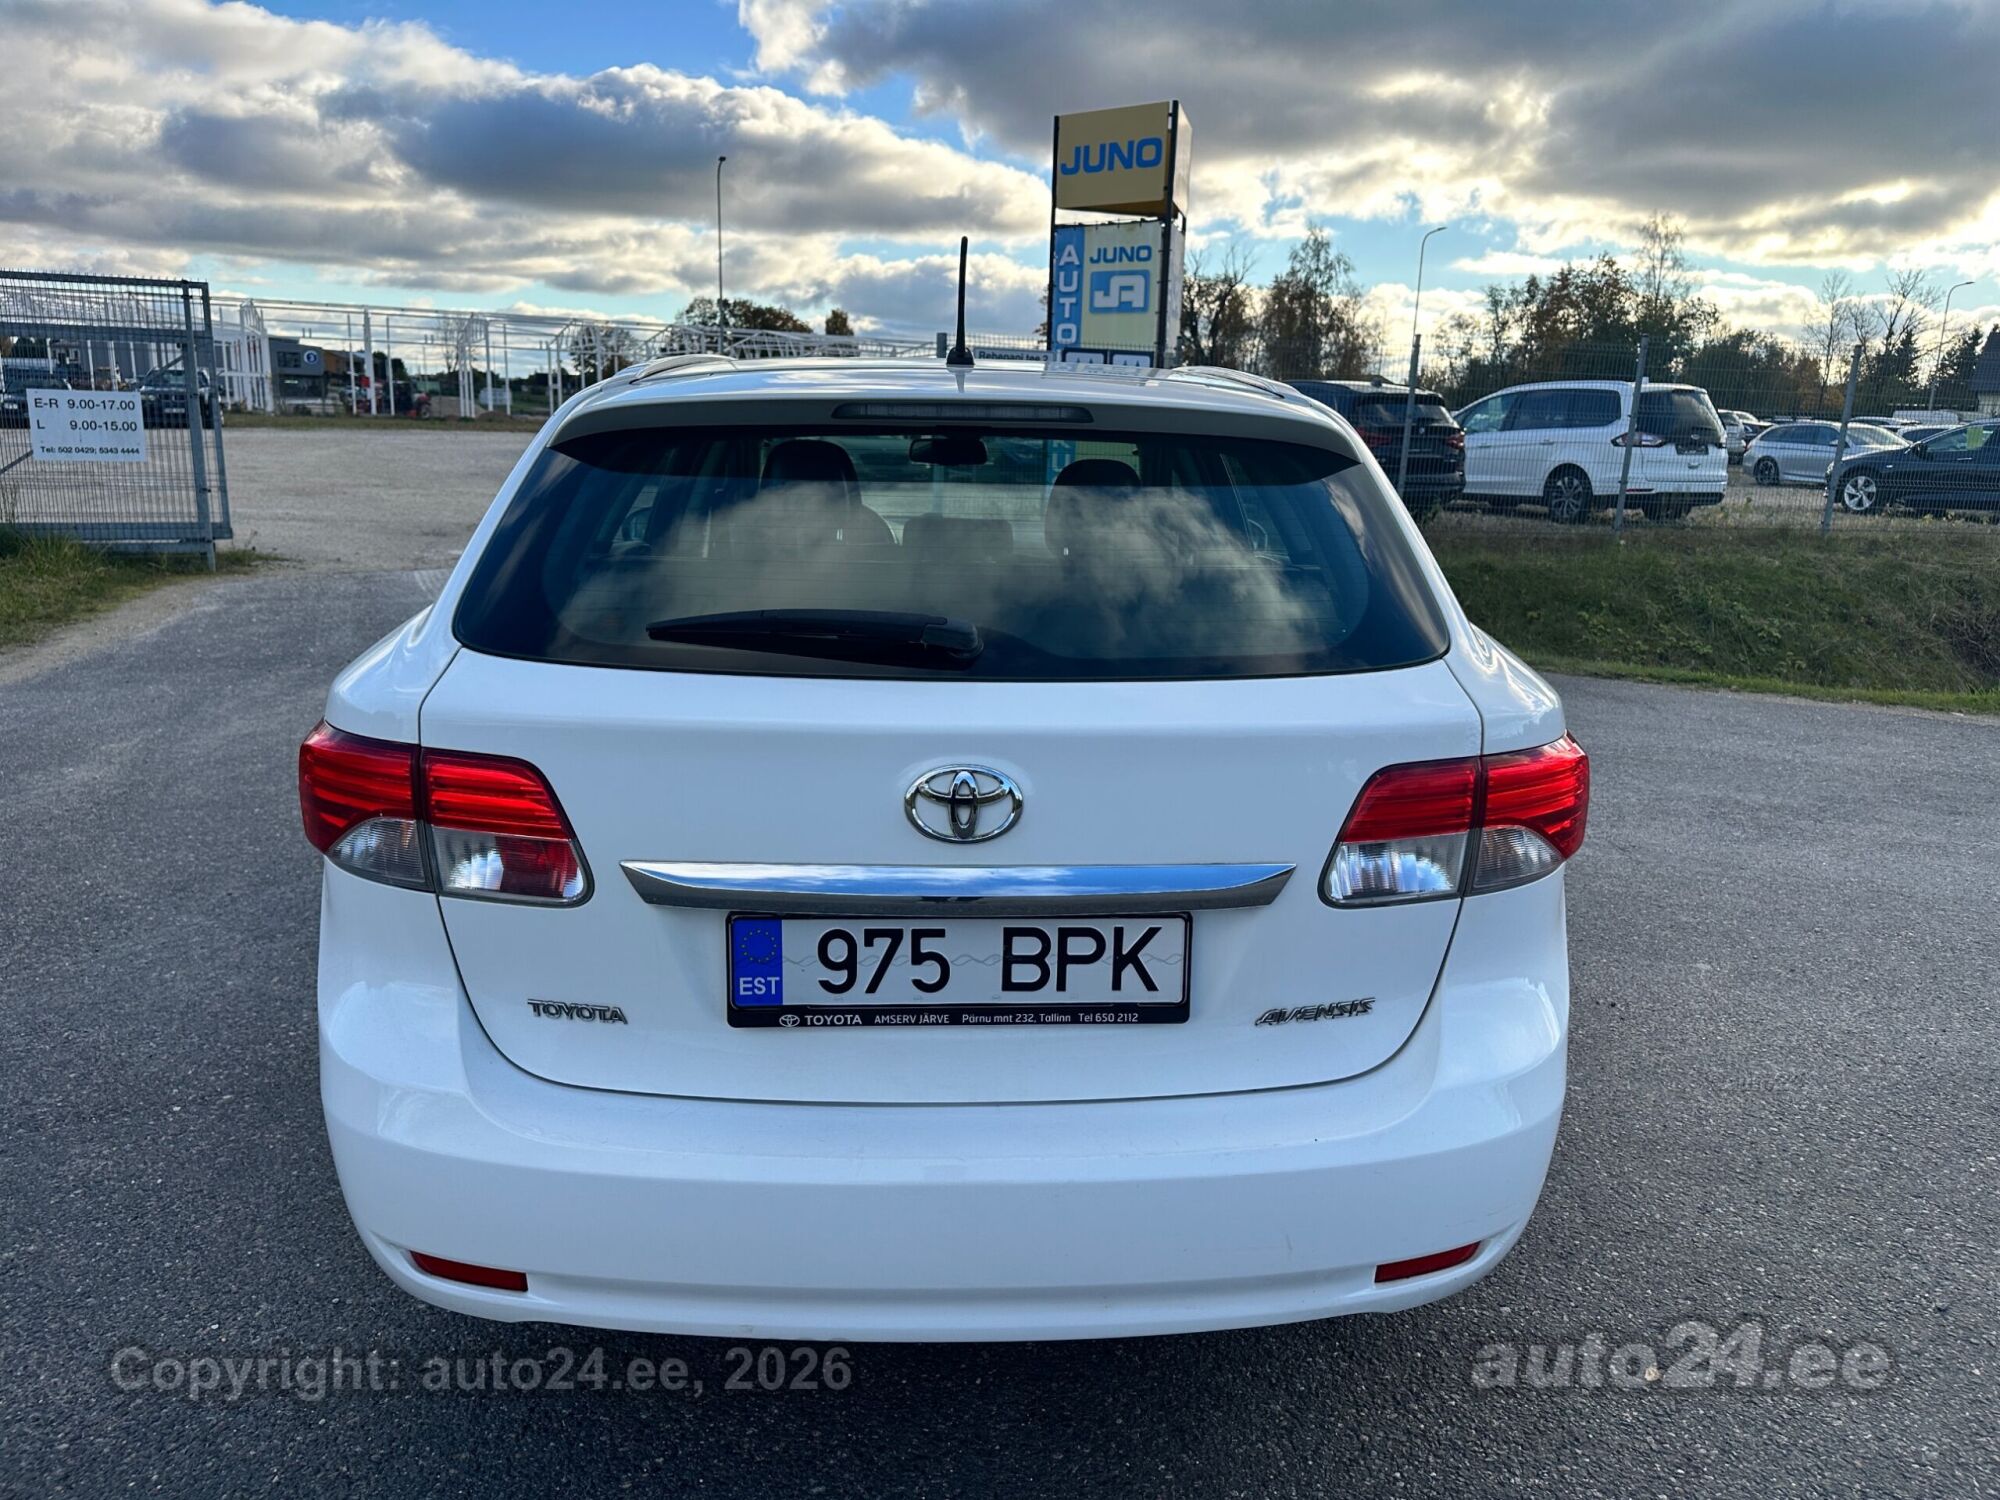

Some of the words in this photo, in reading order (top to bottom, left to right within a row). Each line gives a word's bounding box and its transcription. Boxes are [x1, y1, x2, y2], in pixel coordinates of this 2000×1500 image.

[1060, 137, 1163, 175] JUNO
[1089, 245, 1152, 263] JUNO
[1057, 244, 1080, 344] AUTO
[34, 398, 59, 408] E-R
[67, 399, 135, 410] 9.00-17.00
[36, 419, 45, 429] L
[69, 420, 138, 431] 9.00-15.00
[58, 446, 72, 454] 502
[75, 446, 97, 455] 0429;
[817, 928, 951, 994] 975
[1001, 926, 1162, 992] BPK
[739, 976, 780, 996] EST
[527, 998, 628, 1024] TOYOTA
[804, 1014, 863, 1026] TOYOTA
[874, 1014, 917, 1024] AMSERV
[918, 1012, 950, 1025] JÄRVE
[962, 1013, 991, 1023] Pärnu
[993, 1014, 1013, 1023] mnt
[1015, 1013, 1037, 1024] 232,
[1039, 1013, 1071, 1023] Tallinn
[1078, 1013, 1093, 1022] Tel
[1095, 1013, 1115, 1022] 650
[1117, 1013, 1139, 1022] 2112
[1254, 997, 1376, 1026] AVENSIS
